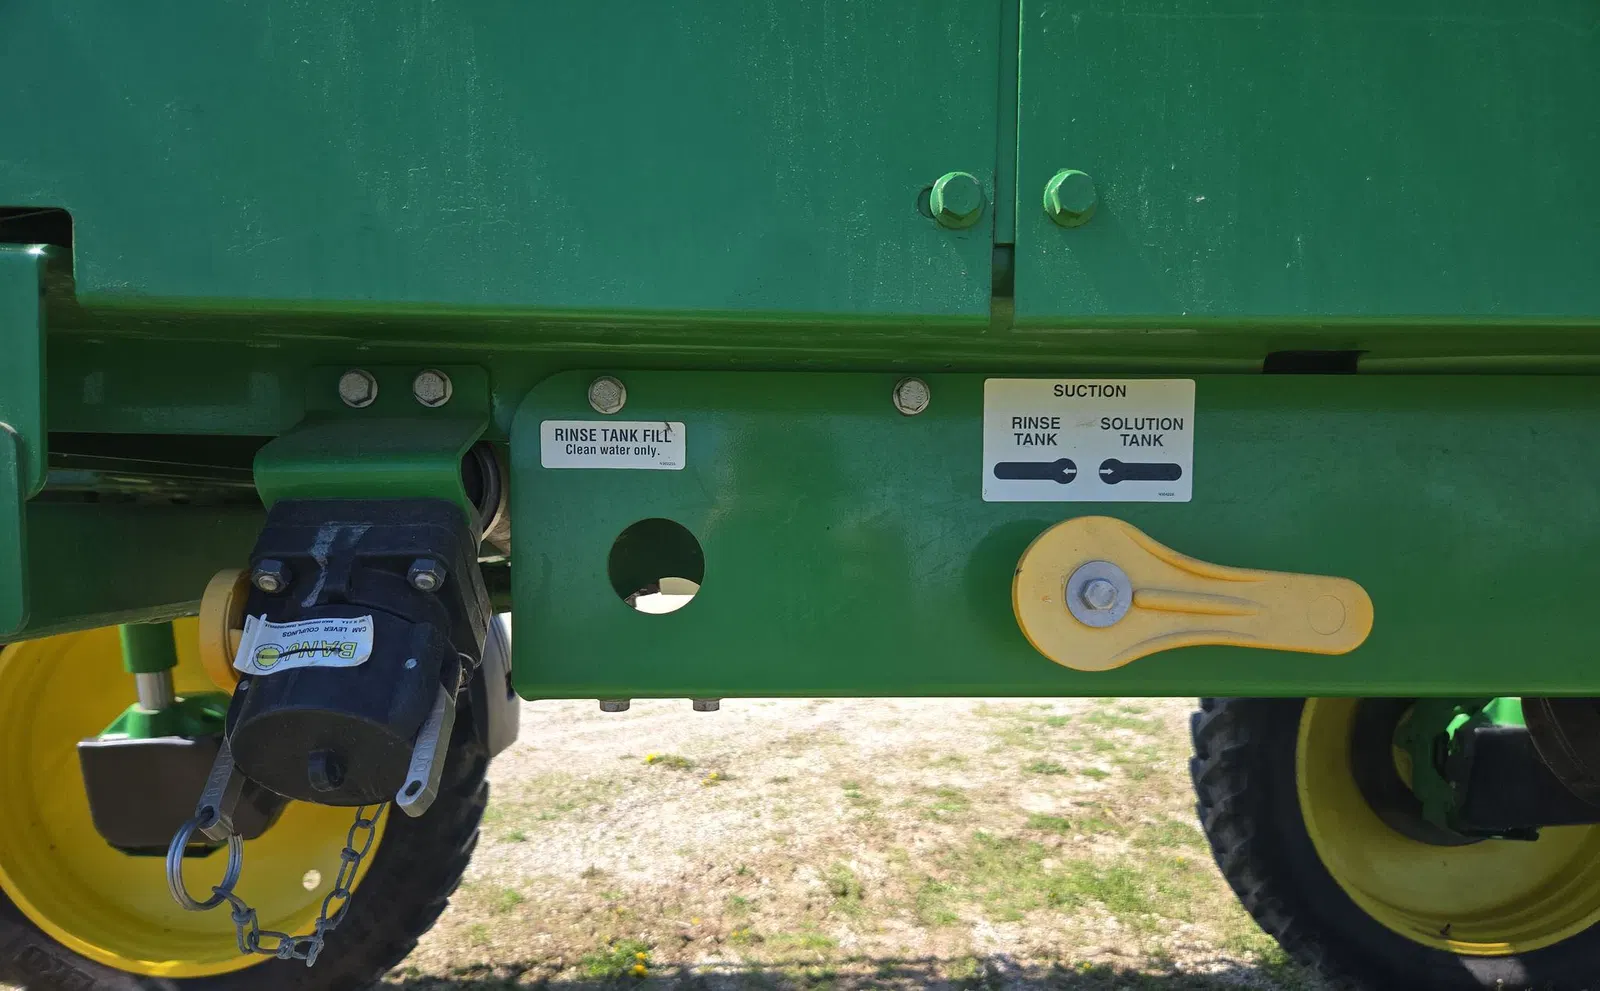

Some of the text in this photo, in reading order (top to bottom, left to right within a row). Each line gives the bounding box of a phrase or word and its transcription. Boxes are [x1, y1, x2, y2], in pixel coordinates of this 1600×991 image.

[1053, 384, 1127, 398] SUCTION
[1011, 416, 1061, 430] RINSE
[1100, 417, 1184, 431] SOLUTION
[554, 428, 672, 443] RINSE TANK FILL
[1014, 433, 1058, 446] TANK
[1120, 434, 1164, 447] TANK
[565, 444, 661, 458] Clean water only.
[282, 626, 320, 638] COUPLINGS
